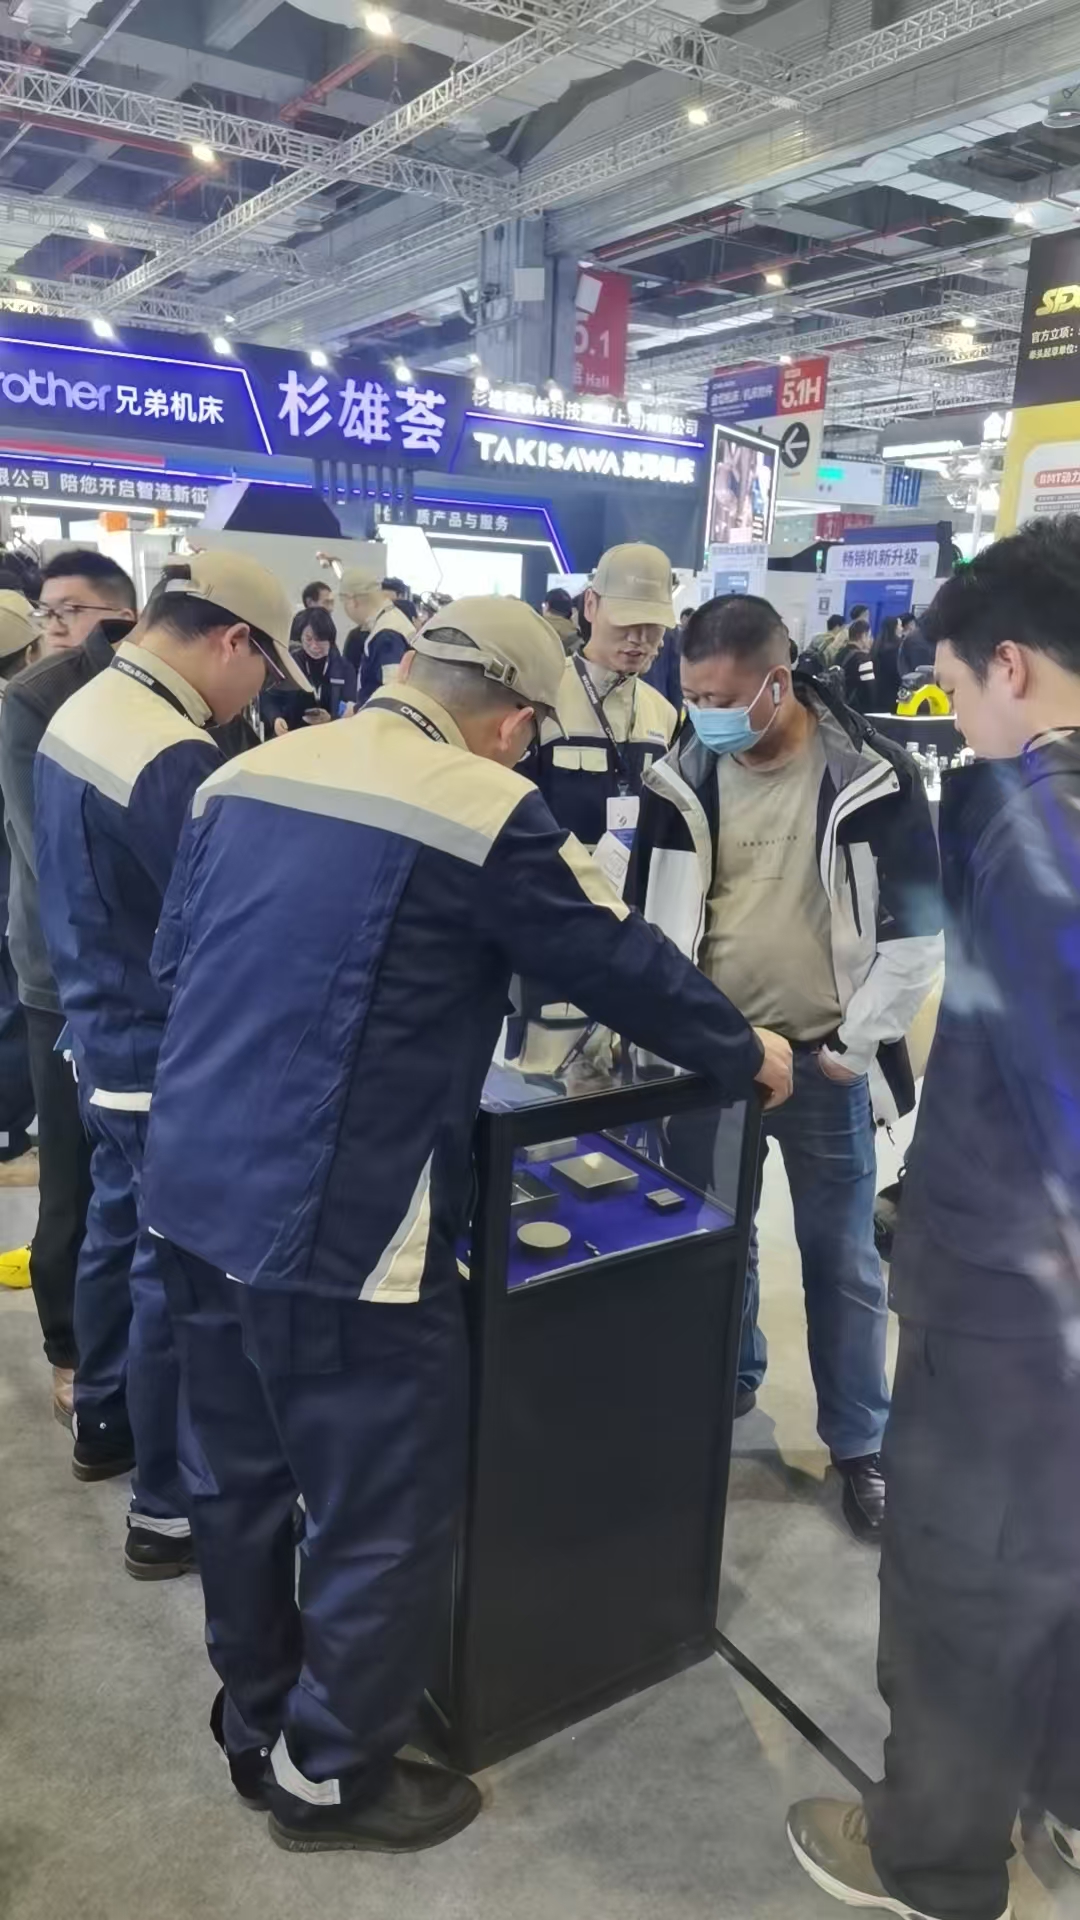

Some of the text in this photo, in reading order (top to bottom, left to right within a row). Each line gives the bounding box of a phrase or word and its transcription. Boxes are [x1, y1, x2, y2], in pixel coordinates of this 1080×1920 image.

[1031, 325, 1080, 344] 官方立项：
[0, 368, 224, 424] other 兄弟机床
[586, 372, 610, 389] Hall
[782, 375, 822, 409] 5.1H
[278, 369, 447, 454] 杉雄荟
[472, 431, 621, 477] TAKISAWA
[842, 548, 919, 568] 畅销机新升级
